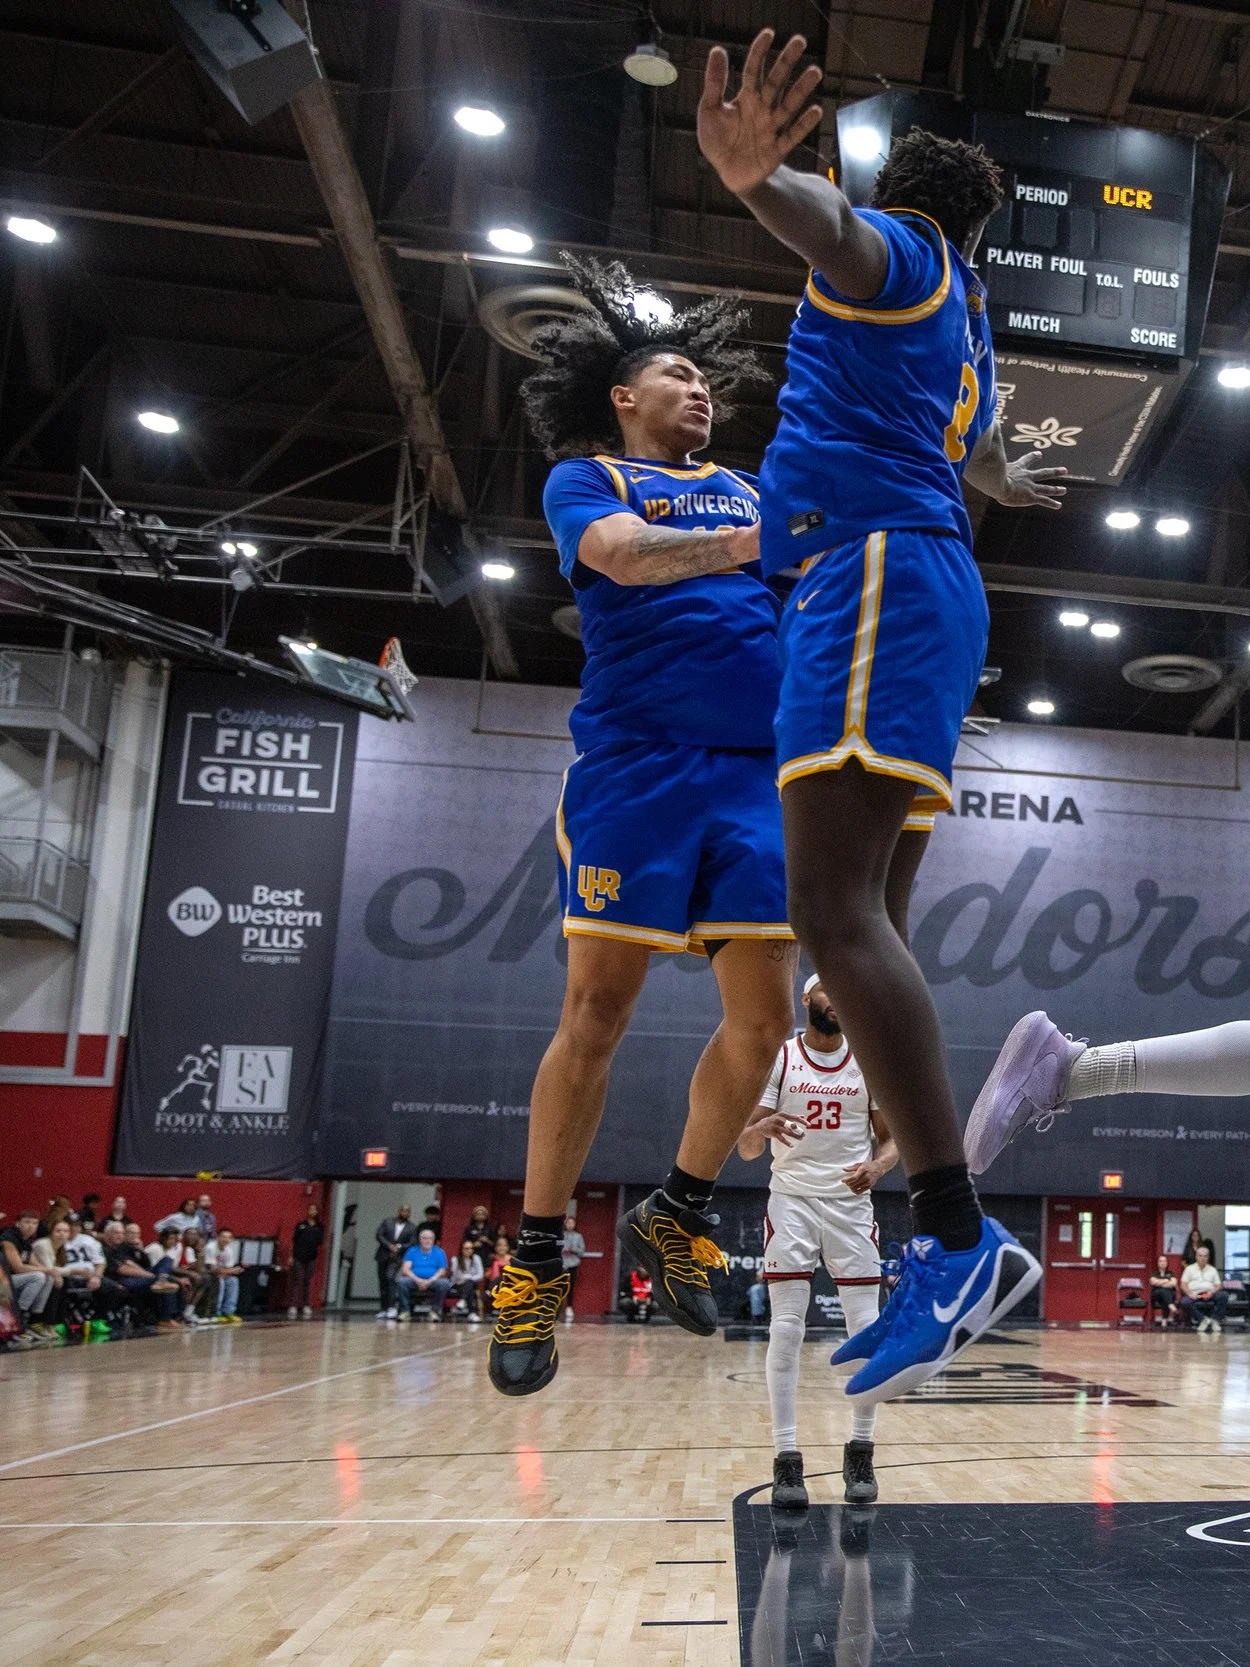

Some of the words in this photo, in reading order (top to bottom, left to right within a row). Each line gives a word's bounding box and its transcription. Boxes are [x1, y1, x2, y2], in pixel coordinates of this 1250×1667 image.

[1015, 184, 1068, 206] PERIOD
[1103, 185, 1153, 210] UCR
[987, 248, 1043, 270] PLAYER
[1050, 256, 1087, 276] FOUL
[1095, 273, 1124, 289] T.O.L.
[1133, 268, 1180, 289] FOULS
[1008, 311, 1060, 334] MATCH
[1130, 328, 1177, 349] SCORE
[215, 707, 317, 731] California
[214, 728, 311, 760] FISH
[198, 765, 320, 799] GRILL
[946, 789, 1085, 826] RENA
[252, 885, 305, 906] Best
[175, 902, 216, 921] BW
[227, 904, 323, 927] Western
[242, 928, 305, 949] PLUS
[789, 1082, 859, 1096] Matadors
[391, 1101, 432, 1113] EVERY
[433, 1102, 484, 1115] PERSON
[806, 1100, 842, 1129] 23
[155, 1112, 208, 1128] FOOT
[209, 1113, 222, 1128] &
[228, 1114, 290, 1130] ANKLE
[1092, 1126, 1128, 1137] EVERY
[1129, 1127, 1174, 1139] PERSON
[1189, 1130, 1224, 1140] EVERY
